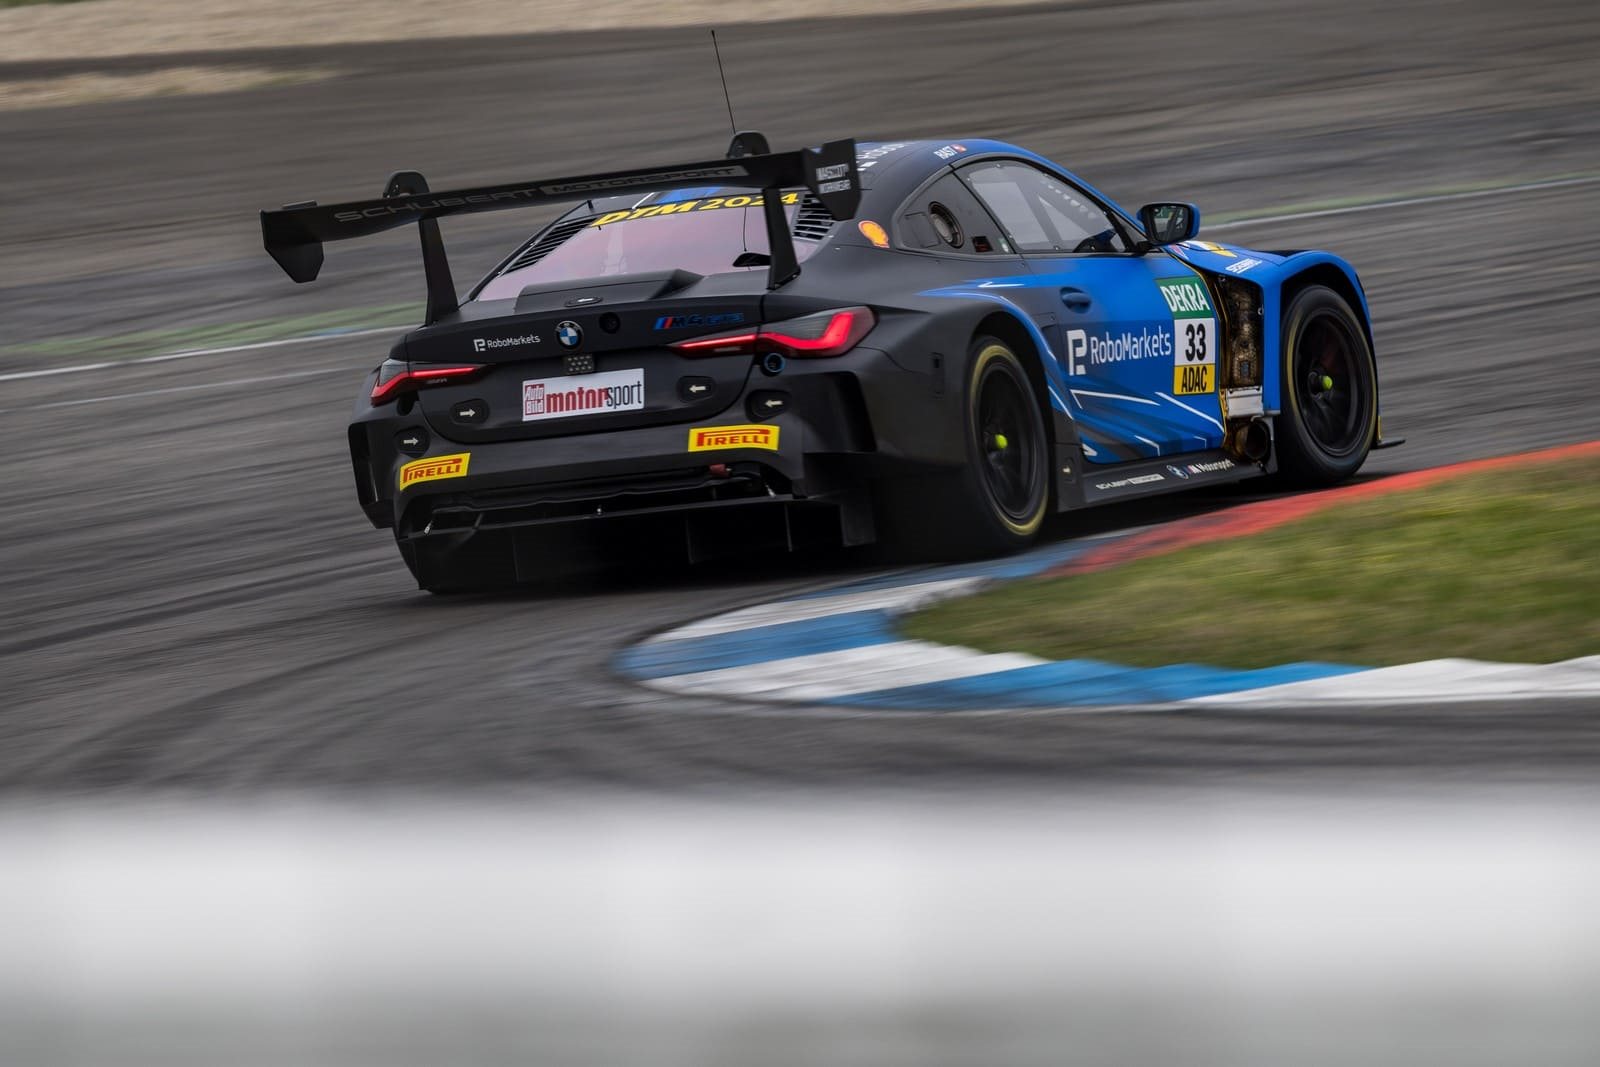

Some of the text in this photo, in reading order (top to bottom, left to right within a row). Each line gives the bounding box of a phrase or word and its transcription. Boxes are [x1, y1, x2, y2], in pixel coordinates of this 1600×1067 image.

[334, 168, 736, 222] SCHUBERT MOTORSPORT
[589, 192, 799, 227] DTM 2024
[1160, 283, 1210, 313] DEKRA
[487, 334, 541, 349] RoboMarkets
[1090, 324, 1172, 365] RoboMarkets
[1184, 322, 1206, 362] 33
[526, 386, 544, 401] Auto
[1181, 367, 1208, 394] ADAC
[526, 401, 544, 415] Bild
[696, 428, 770, 447] PIRELLI
[402, 457, 462, 484] PIRELLI
